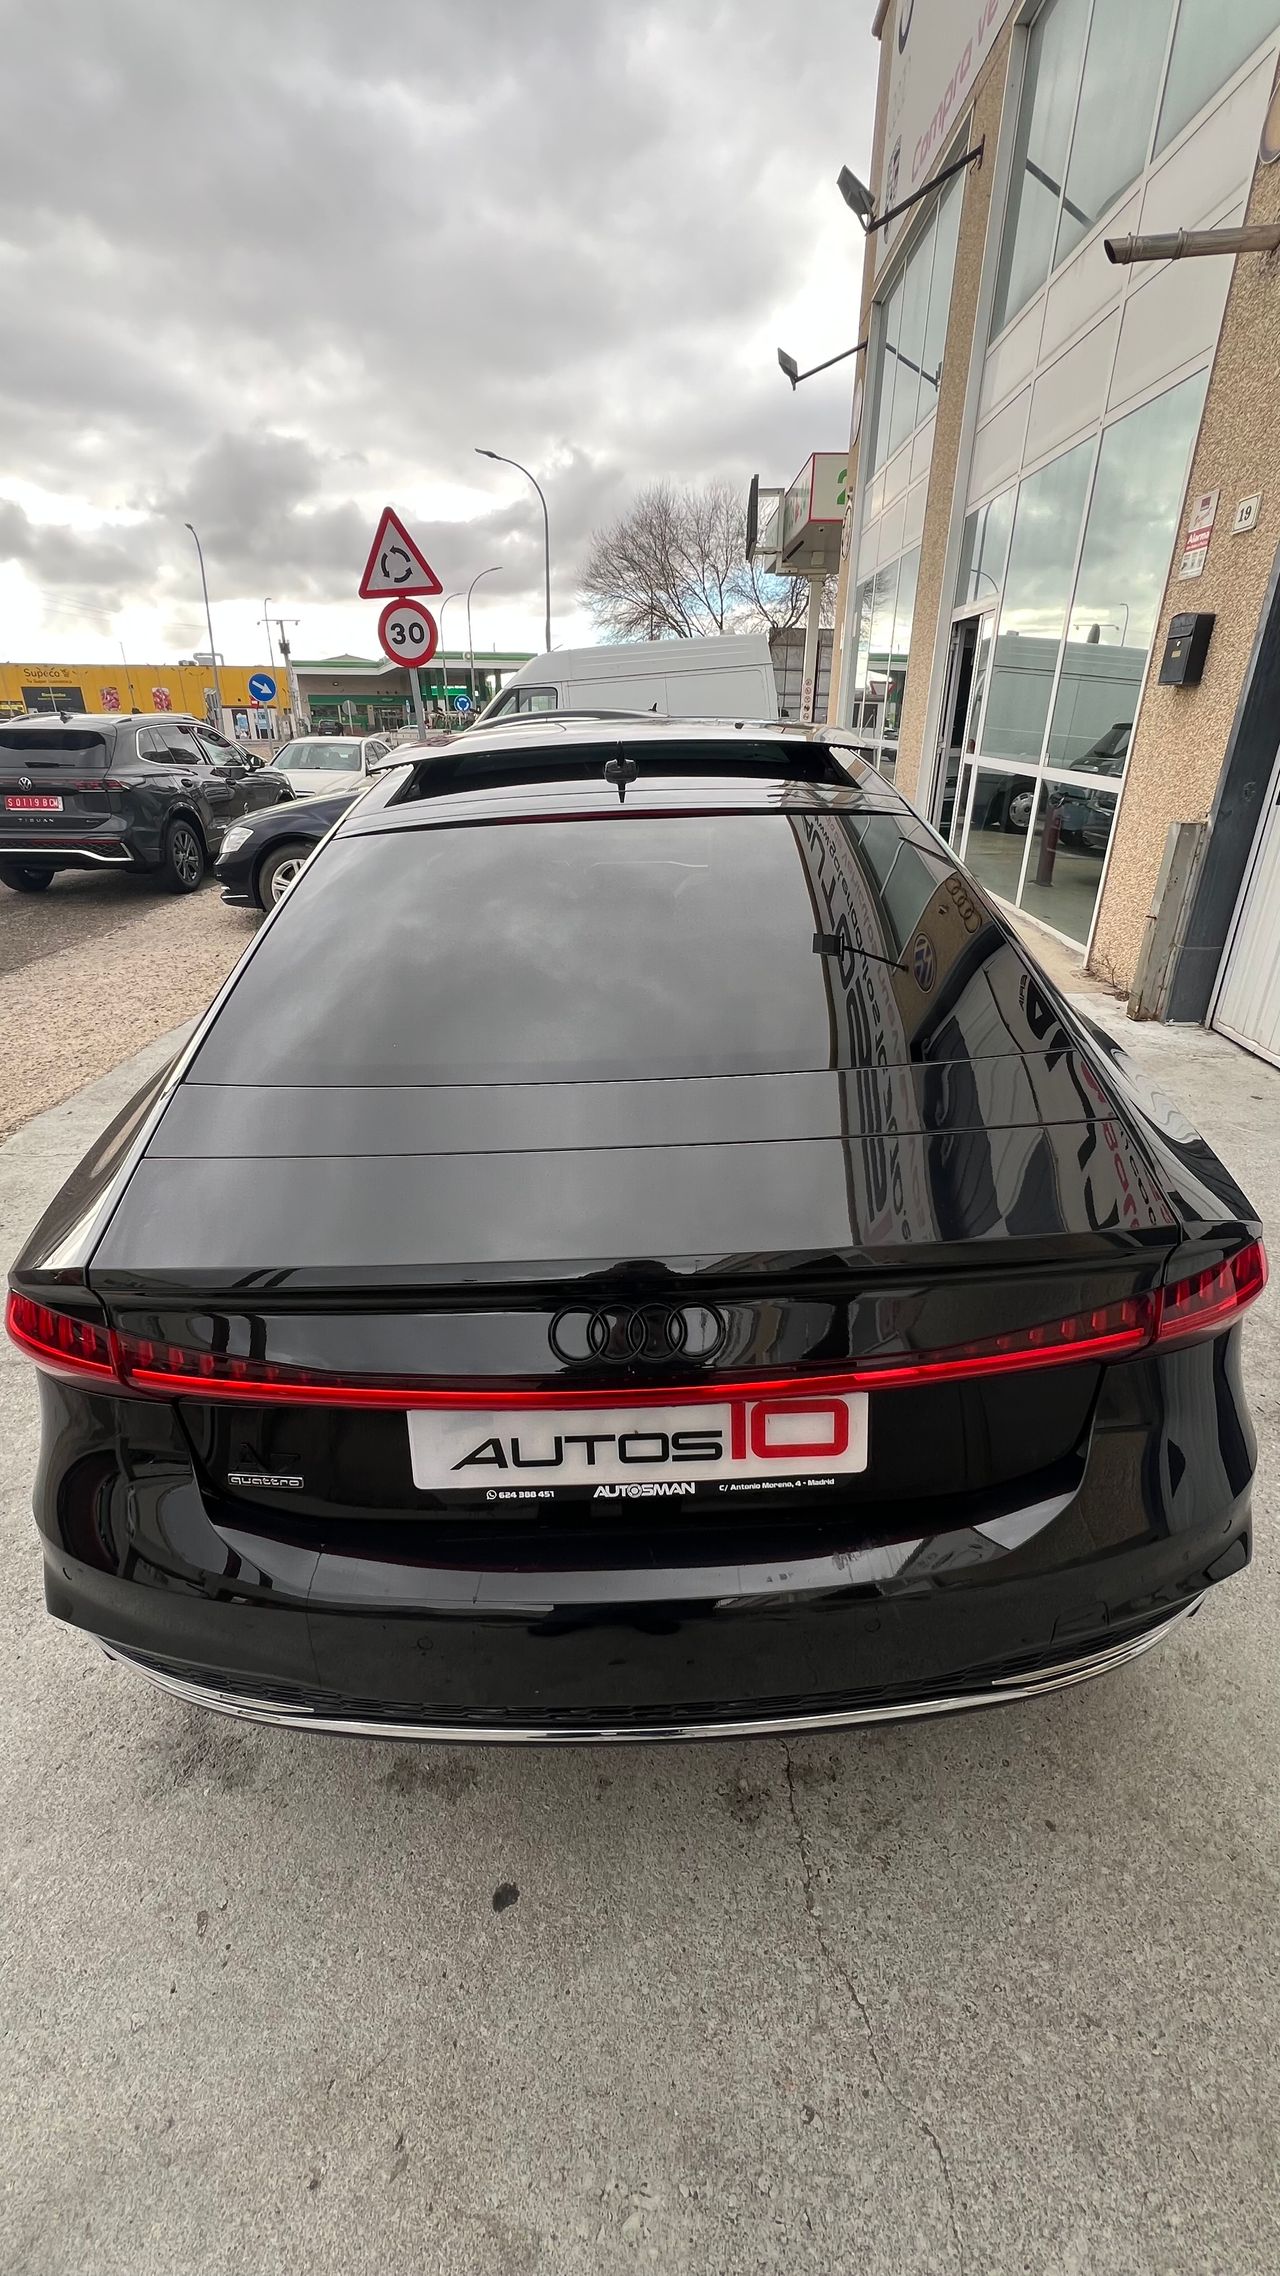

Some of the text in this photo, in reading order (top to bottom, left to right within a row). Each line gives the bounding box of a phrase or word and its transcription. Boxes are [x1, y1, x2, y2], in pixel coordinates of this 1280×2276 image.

[1238, 505, 1252, 523] 19
[1187, 531, 1210, 545] Alarma
[390, 622, 425, 645] 30
[7, 798, 13, 807] S
[15, 798, 40, 807] 0119
[231, 1477, 300, 1487] quattro
[719, 1484, 728, 1492] C/
[730, 1482, 761, 1491] Antonio
[762, 1480, 795, 1490] Moreno,
[808, 1478, 835, 1486] Madrid
[498, 1491, 517, 1499] 624
[537, 1490, 555, 1498] 451
[593, 1482, 696, 1498] AUTOSMAN
